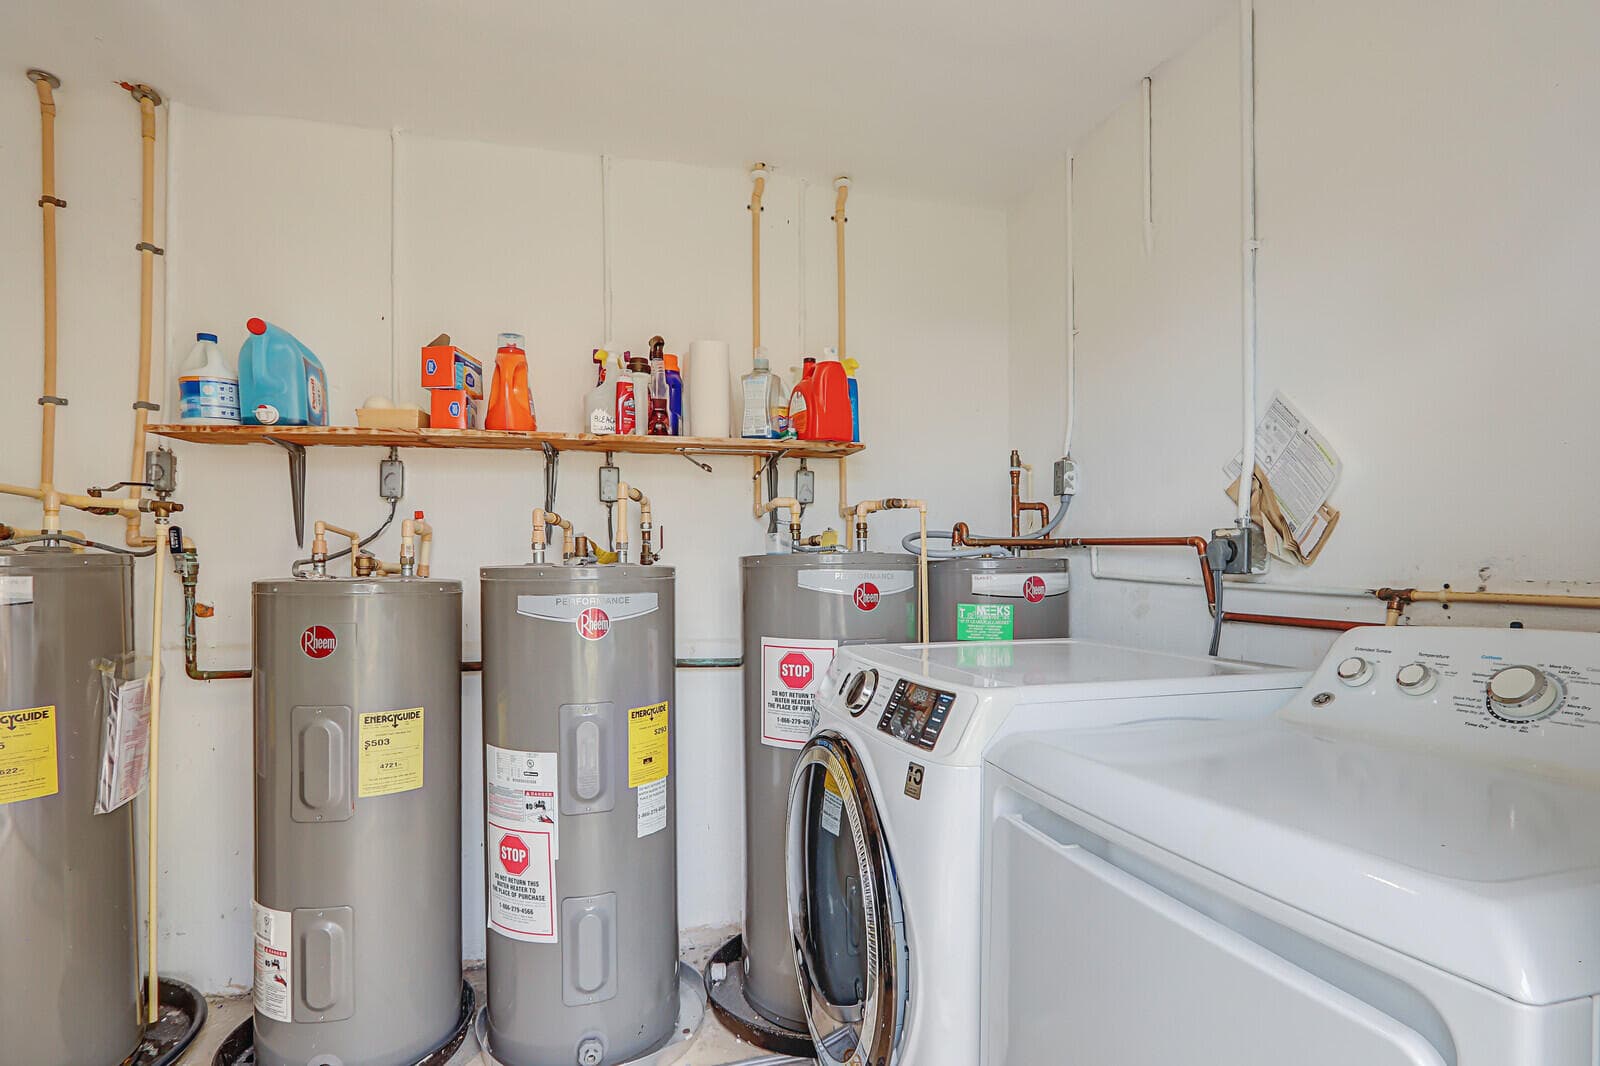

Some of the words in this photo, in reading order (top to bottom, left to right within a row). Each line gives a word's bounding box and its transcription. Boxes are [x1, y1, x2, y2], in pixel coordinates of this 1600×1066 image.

[1026, 576, 1045, 599] Rheem
[856, 583, 879, 608] Rheem
[581, 608, 609, 635] Rheem
[304, 625, 335, 654] Rheem
[781, 663, 810, 678] STOP
[631, 704, 666, 719] ENERGYGUIDE
[777, 703, 791, 711] PLACE
[364, 711, 421, 724] ENERGYGUIDE
[364, 738, 390, 748] $503
[501, 846, 527, 863] STOP
[508, 876, 526, 886] RETURN
[510, 884, 528, 893] HEATER
[499, 887, 511, 897] PLACE
[518, 893, 546, 901] PURCHASE
